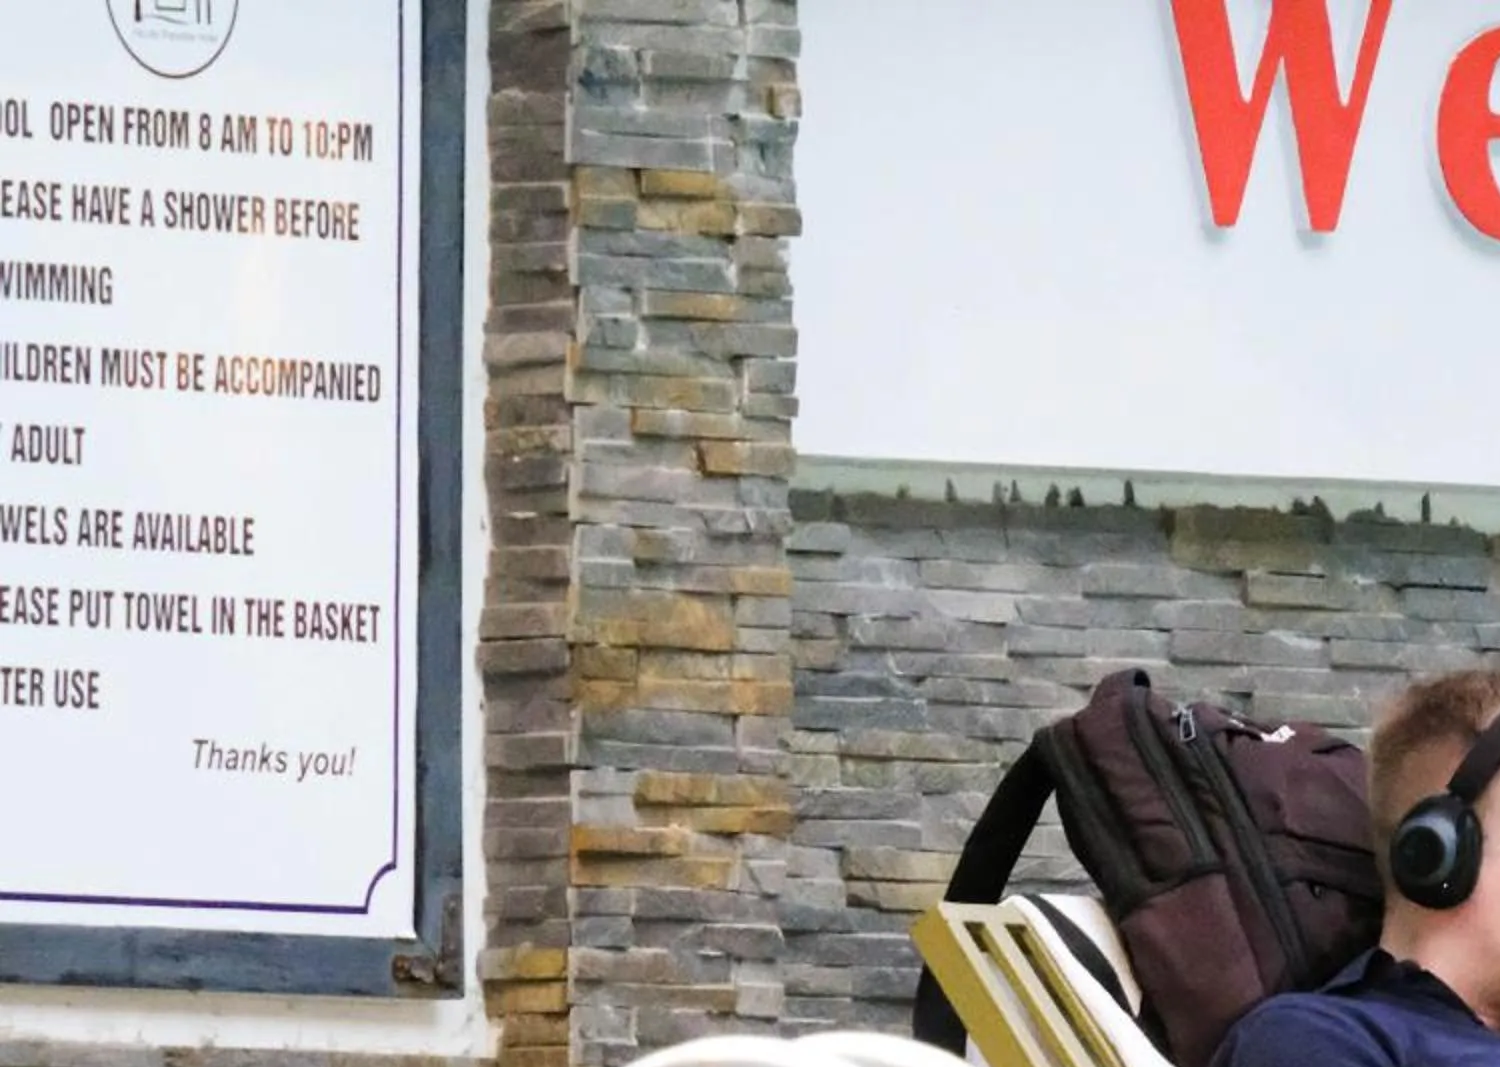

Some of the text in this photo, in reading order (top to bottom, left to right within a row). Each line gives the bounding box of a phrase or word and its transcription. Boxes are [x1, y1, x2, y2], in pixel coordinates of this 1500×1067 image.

[0, 98, 373, 162] OL OPEN FROM 8 AM TO 10:PM
[72, 184, 131, 225] HAVE
[140, 189, 155, 228] A
[163, 190, 265, 234] SHOWER
[275, 198, 359, 241] BEFORE
[0, 341, 380, 404] ILDREN MUST BE ACCOMPANIED
[11, 423, 85, 465] ADULT
[77, 508, 123, 549] ARE
[132, 512, 255, 556] AVAILABLE
[69, 589, 115, 630] PUT
[123, 592, 202, 634] TOWEL
[211, 597, 235, 636] IN
[244, 598, 285, 638] THE
[294, 601, 381, 643] BASKET
[54, 669, 100, 709] USE
[193, 739, 356, 782] Thanks you!
